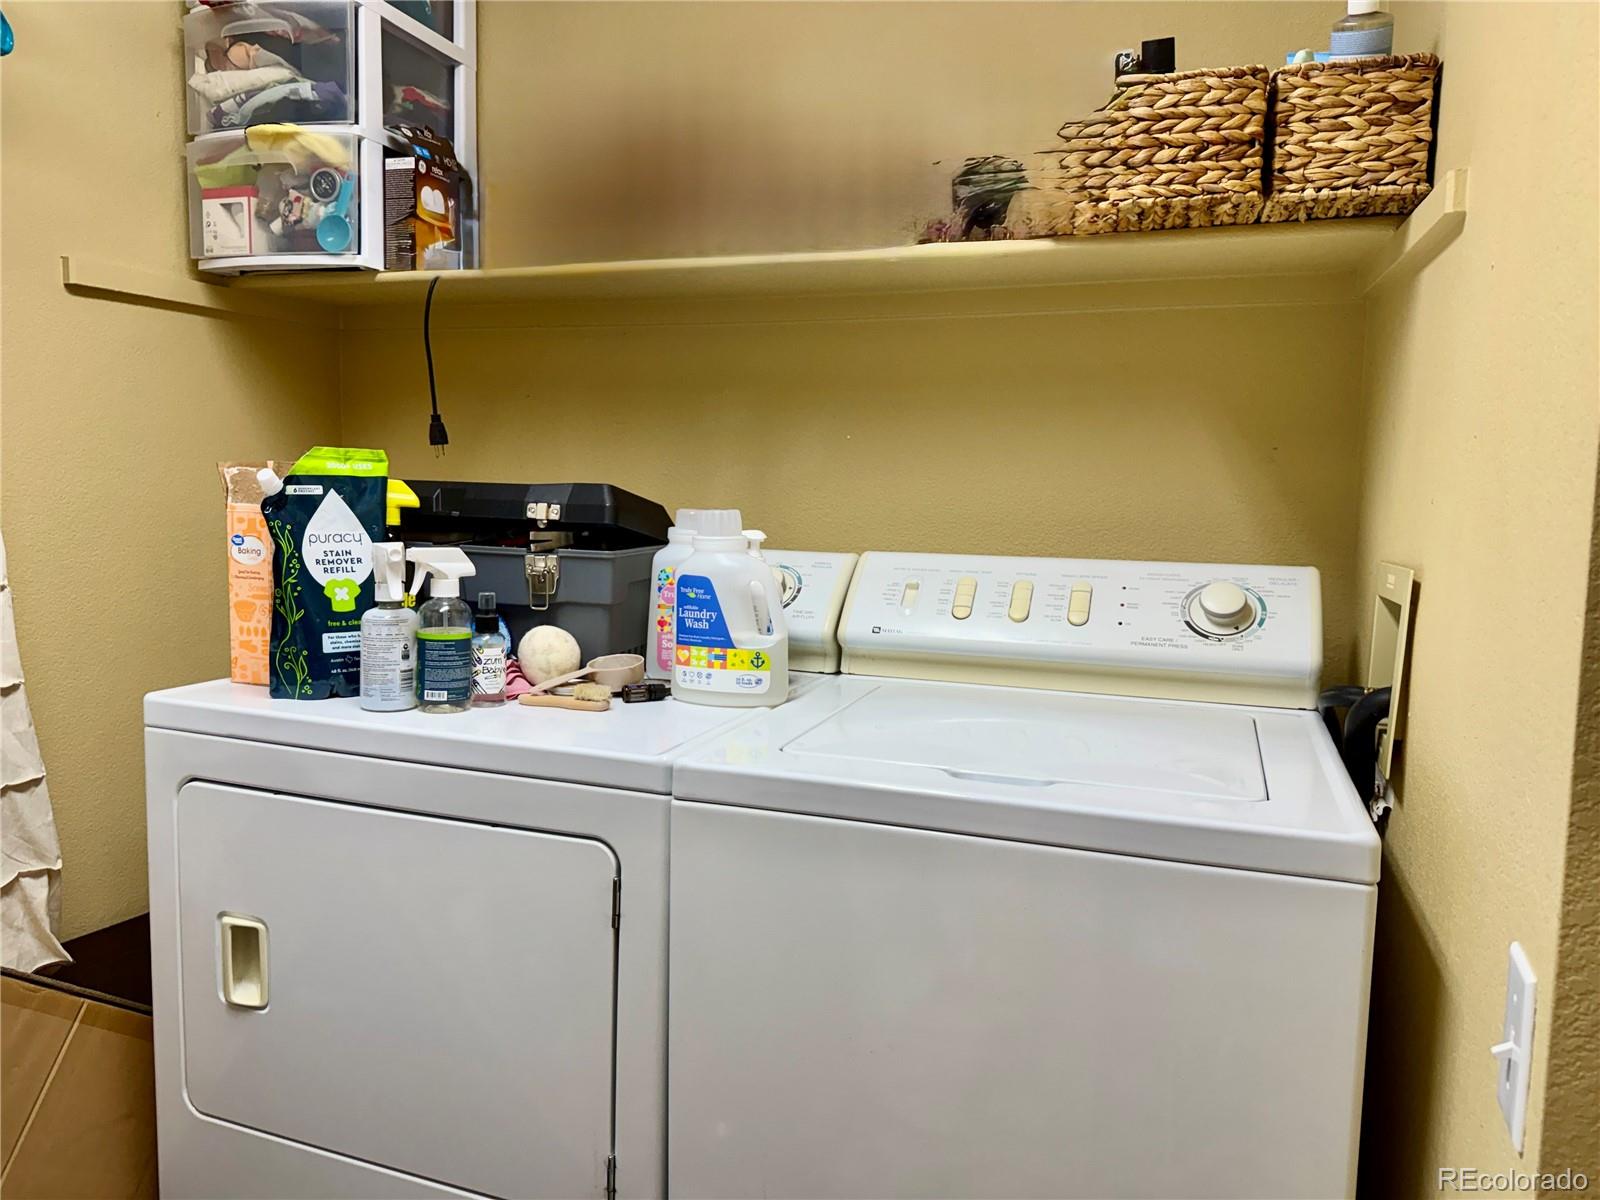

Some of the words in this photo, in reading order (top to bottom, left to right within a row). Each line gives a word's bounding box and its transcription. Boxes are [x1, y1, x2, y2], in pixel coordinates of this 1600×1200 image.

[308, 532, 363, 547] puracy
[237, 547, 262, 557] Baking
[315, 557, 363, 566] REMOVER
[323, 566, 356, 574] REFILL
[679, 607, 717, 622] Laundry
[684, 618, 709, 629] Wash
